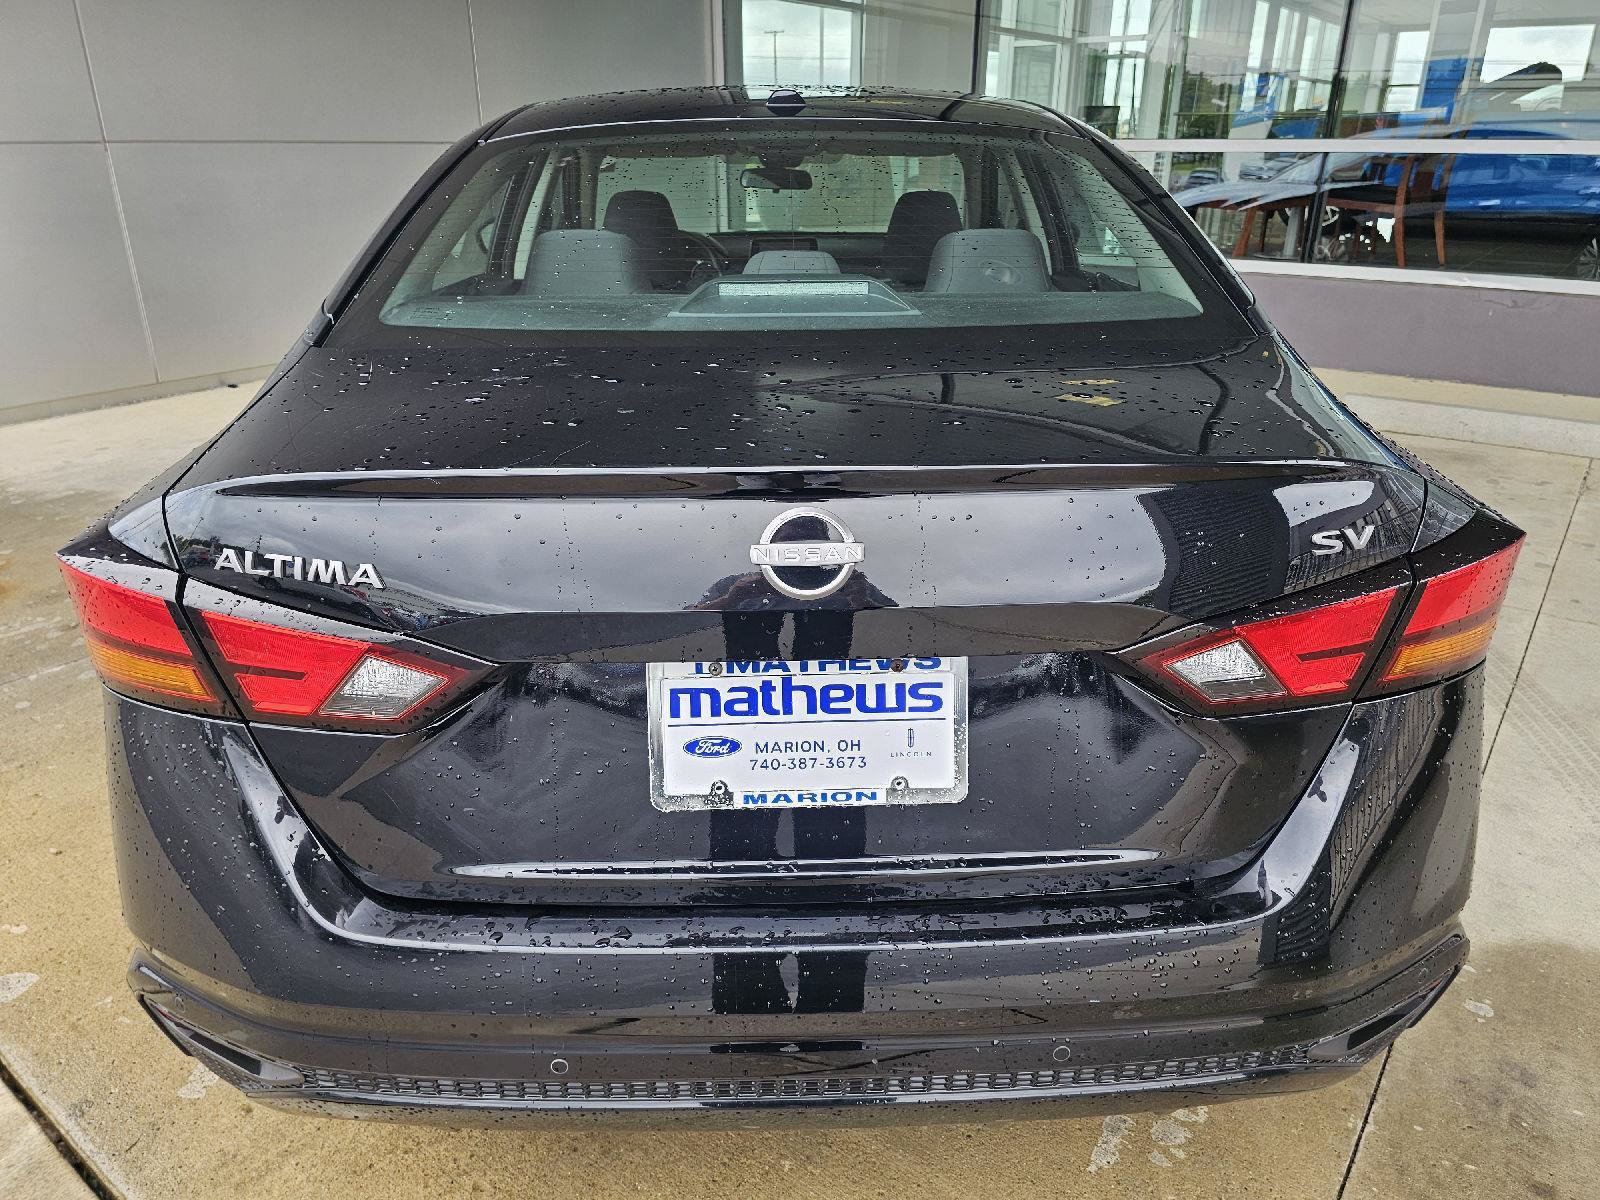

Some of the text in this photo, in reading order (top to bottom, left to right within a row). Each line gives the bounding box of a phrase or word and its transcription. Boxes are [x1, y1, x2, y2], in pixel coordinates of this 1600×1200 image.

[1311, 525, 1376, 556] SV
[753, 547, 862, 562] NISSAN
[214, 548, 387, 589] ALTIMA
[669, 676, 944, 719] mathews
[695, 739, 731, 754] Ford
[755, 739, 861, 756] MARION, OH
[750, 756, 867, 771] 740-387-3673
[743, 791, 877, 805] MARION
